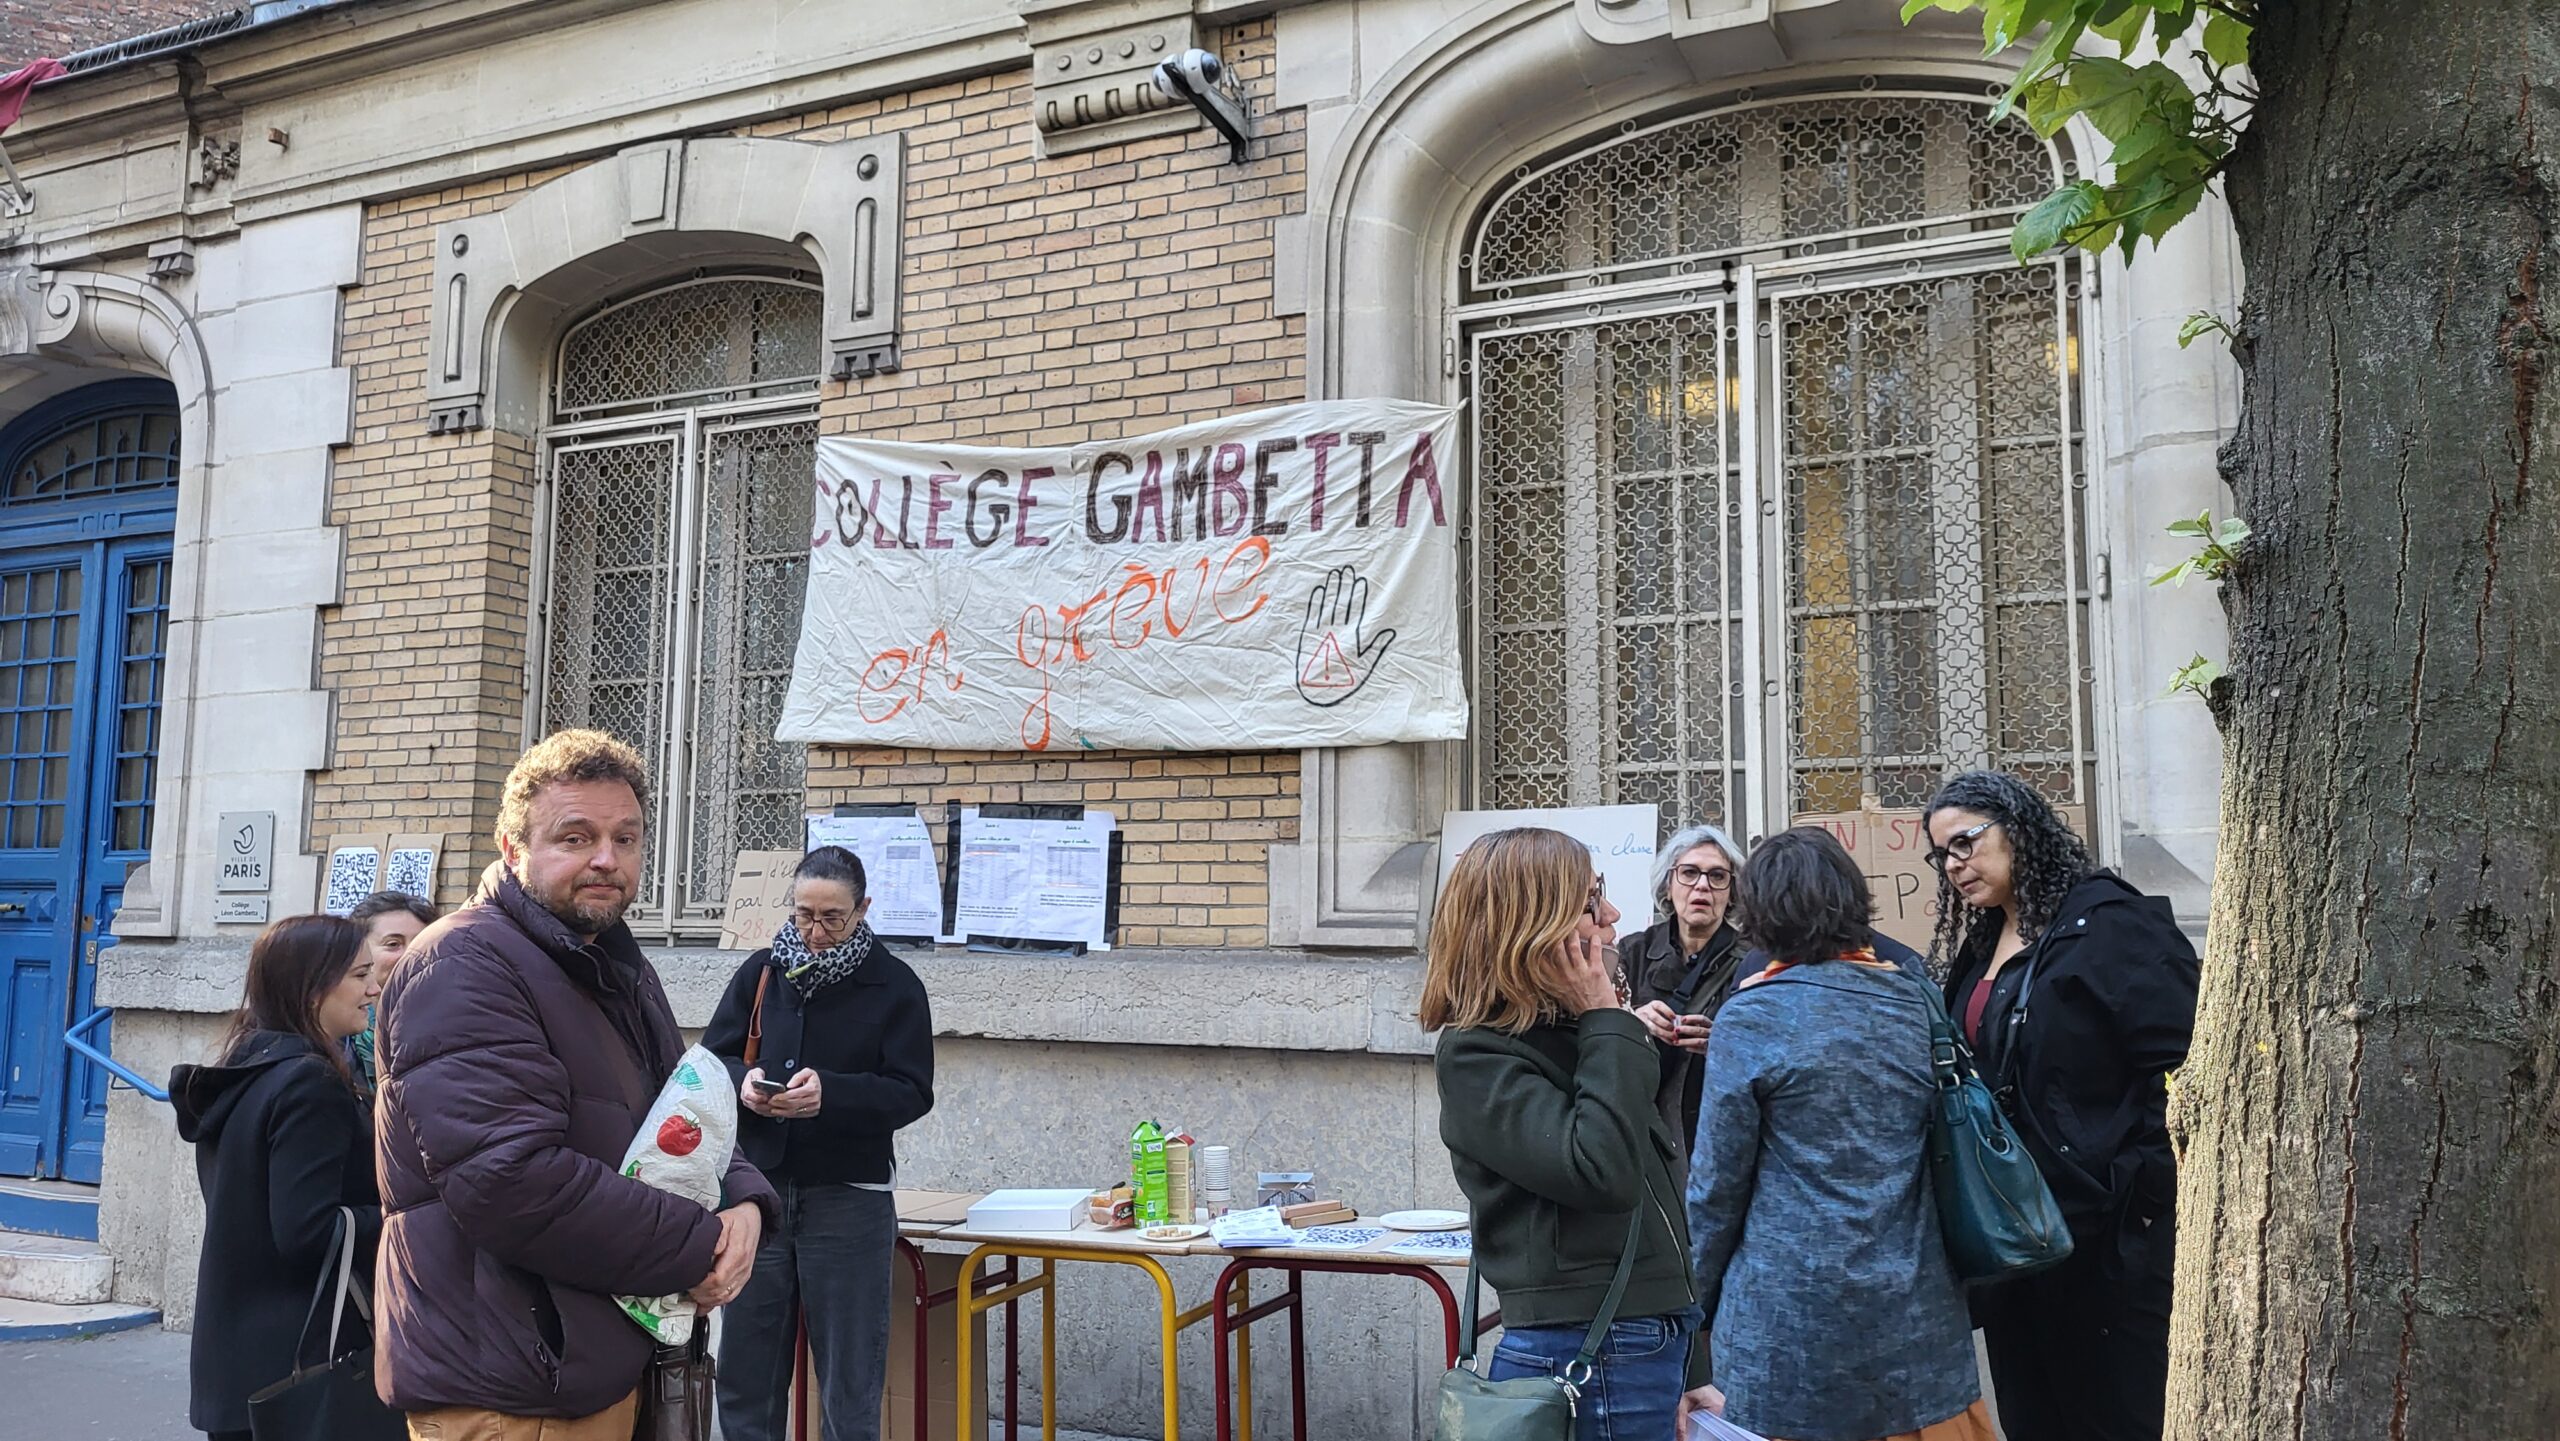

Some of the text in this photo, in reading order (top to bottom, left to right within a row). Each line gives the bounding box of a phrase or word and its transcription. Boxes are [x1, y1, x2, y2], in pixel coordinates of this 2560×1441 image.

[1086, 430, 1447, 545] GAMBETTA
[857, 535, 1270, 752] en grève
[1611, 832, 1653, 856] classe
[224, 863, 261, 878] PARIS
[732, 896, 762, 923] par
